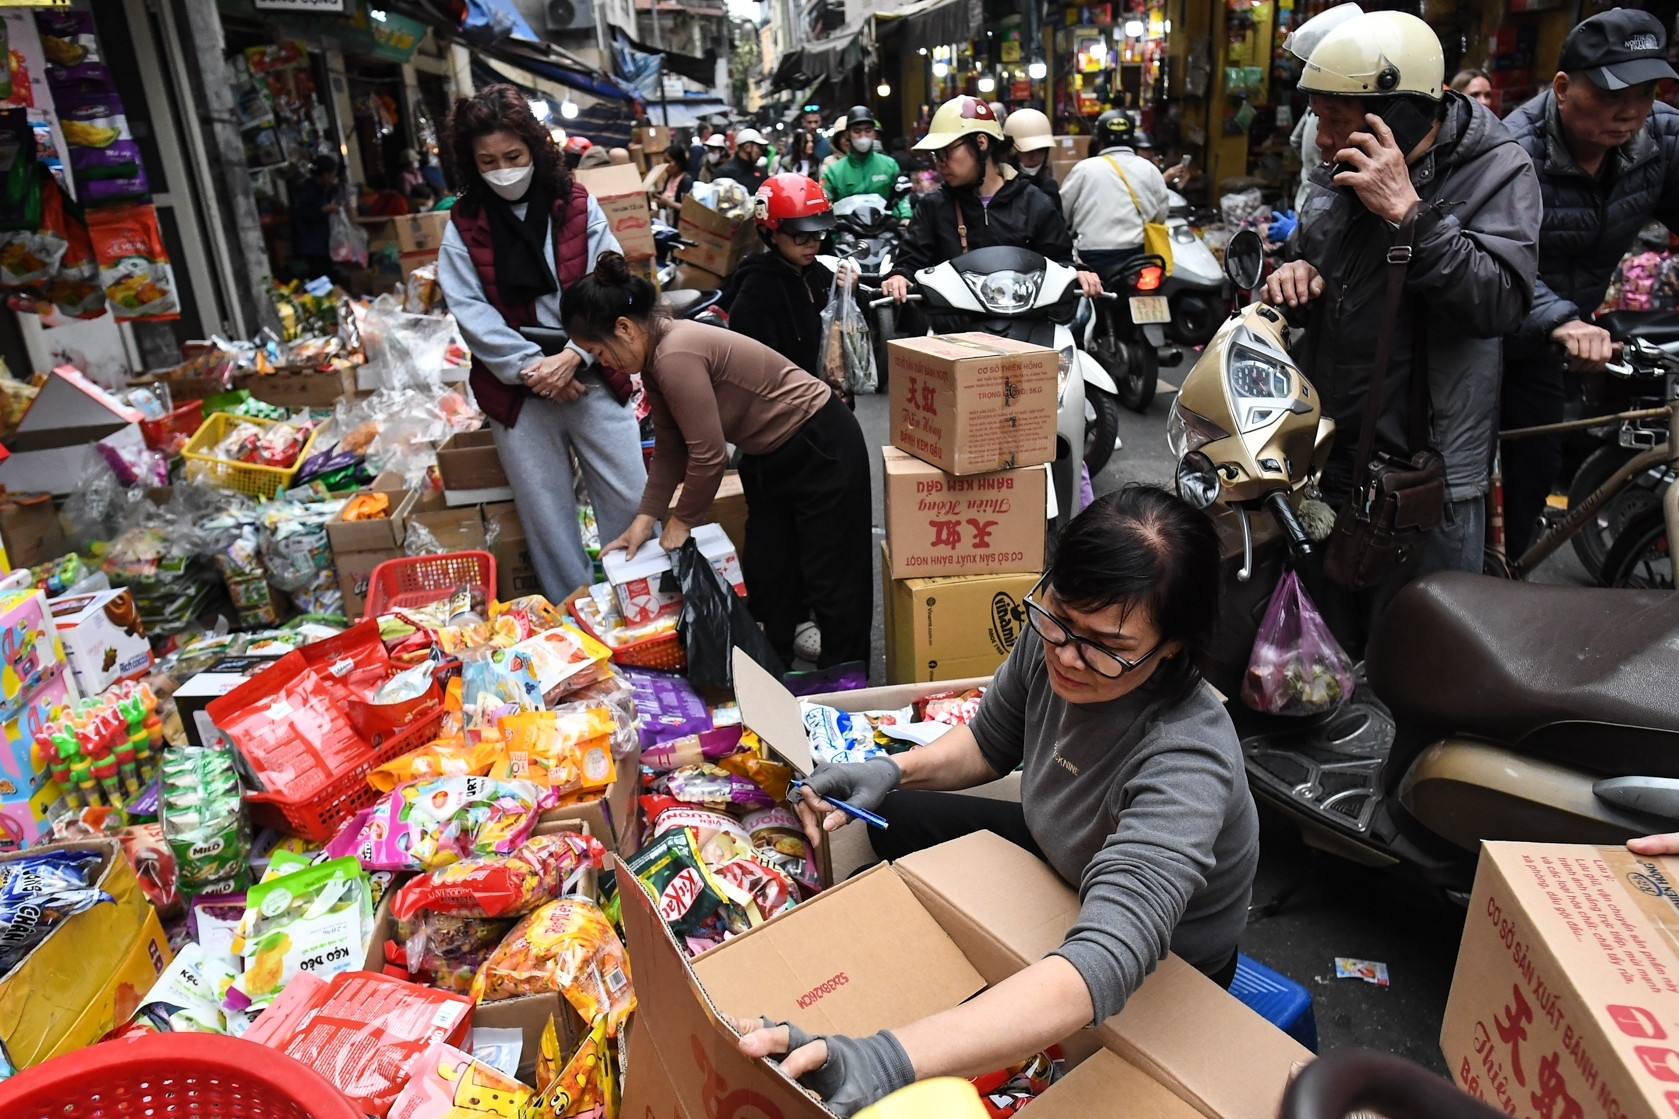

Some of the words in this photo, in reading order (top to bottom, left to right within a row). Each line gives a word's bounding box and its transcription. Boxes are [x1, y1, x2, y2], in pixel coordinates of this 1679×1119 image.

[947, 480, 973, 492] KEM
[978, 477, 1014, 493] BÁNH
[967, 498, 1011, 514] Thiên
[928, 518, 999, 551] 天虹
[931, 554, 953, 567] BÁNH
[193, 843, 220, 855] MILO
[661, 869, 697, 919] KitKat
[796, 971, 849, 1010] 52x38x26CM
[1473, 1020, 1517, 1116] Thiên
